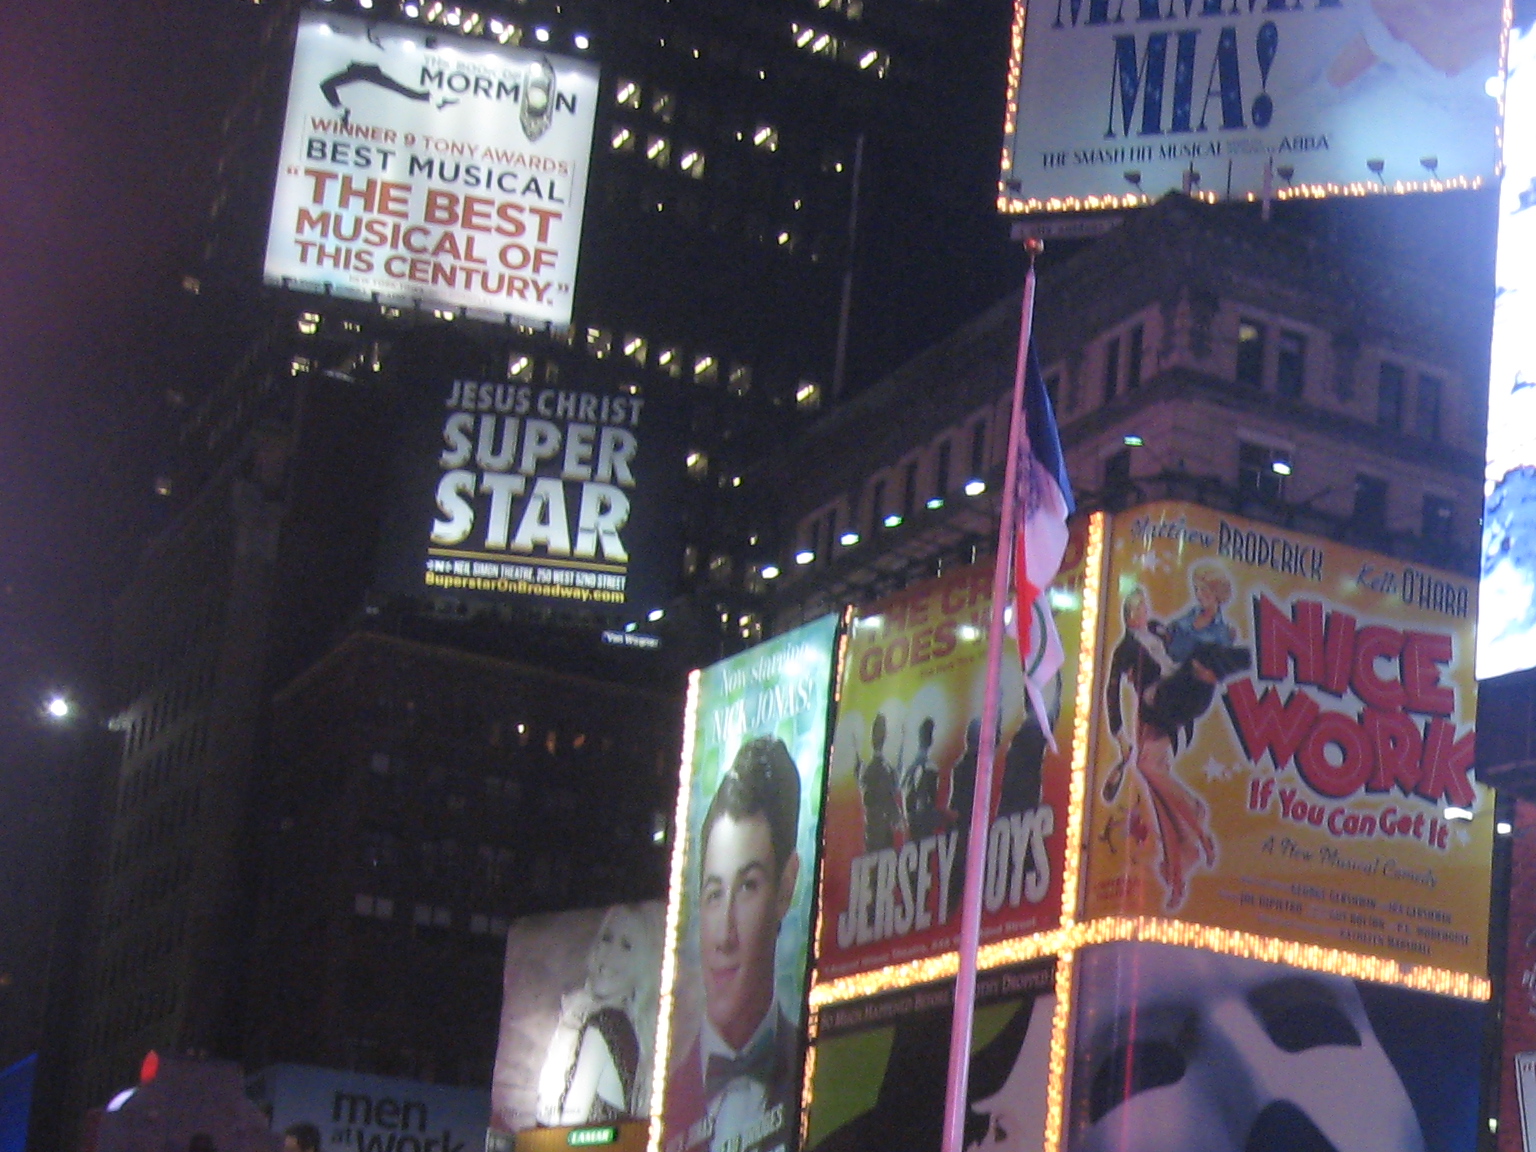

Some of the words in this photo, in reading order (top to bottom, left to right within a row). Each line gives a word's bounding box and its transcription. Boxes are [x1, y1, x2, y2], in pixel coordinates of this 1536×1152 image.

[1103, 20, 1279, 138] MIA!
[306, 138, 397, 172] BEST
[408, 155, 566, 203] MUSICAL
[310, 116, 398, 146] WINNER
[404, 132, 416, 147] 9
[423, 135, 478, 157] TONY
[482, 147, 569, 176] AWARDS
[1072, 147, 1125, 165] SMASH
[294, 206, 488, 266] MUSICAL
[498, 244, 560, 275] OF
[424, 186, 562, 244] BEST
[293, 239, 375, 273] THIS
[446, 379, 531, 416] JESUS
[537, 388, 646, 428] CHRIST
[439, 411, 638, 489] SUPER
[430, 469, 631, 563] STAR
[1217, 519, 1324, 582] BRODERICK
[1401, 566, 1469, 618] O'HARA
[721, 668, 746, 698] Now
[1254, 594, 1455, 716] NICE
[1223, 679, 1476, 807] WORK
[1248, 778, 1271, 810] If
[1278, 788, 1325, 832] You
[1327, 806, 1376, 838] Can
[1379, 808, 1425, 838] Get
[1428, 820, 1450, 848] It
[836, 830, 959, 949] JERSEY
[331, 1090, 428, 1133] men
